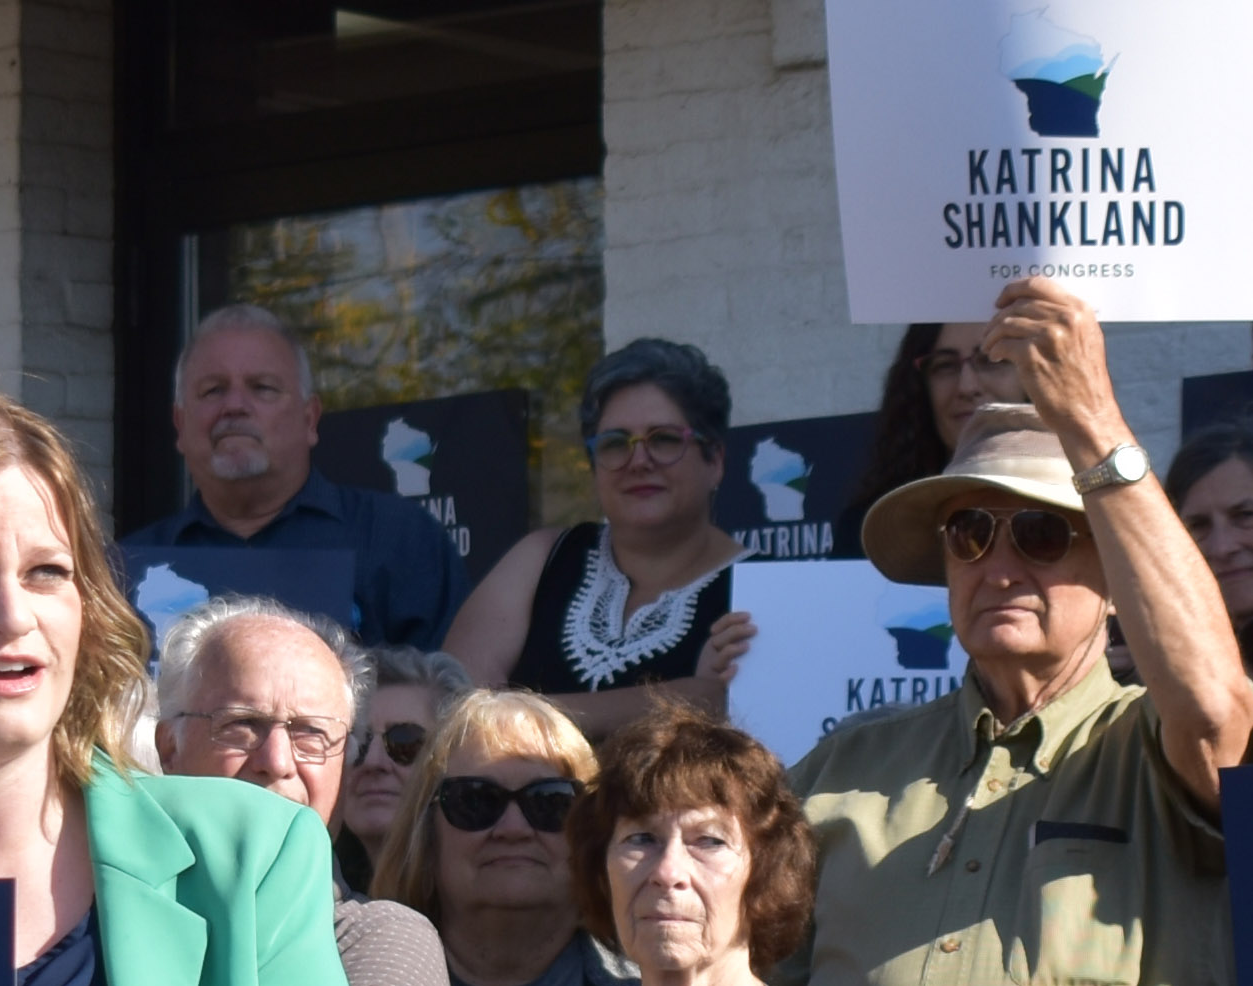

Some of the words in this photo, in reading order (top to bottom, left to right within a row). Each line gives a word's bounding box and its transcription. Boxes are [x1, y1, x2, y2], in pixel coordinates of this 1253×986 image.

[968, 147, 1157, 196] KATRINA
[942, 200, 1187, 249] SHANKLAND
[990, 265, 1022, 279] FOR
[1028, 263, 1135, 278] CONGRESS
[734, 521, 835, 558] KATRINA
[846, 676, 961, 712] KATRI
